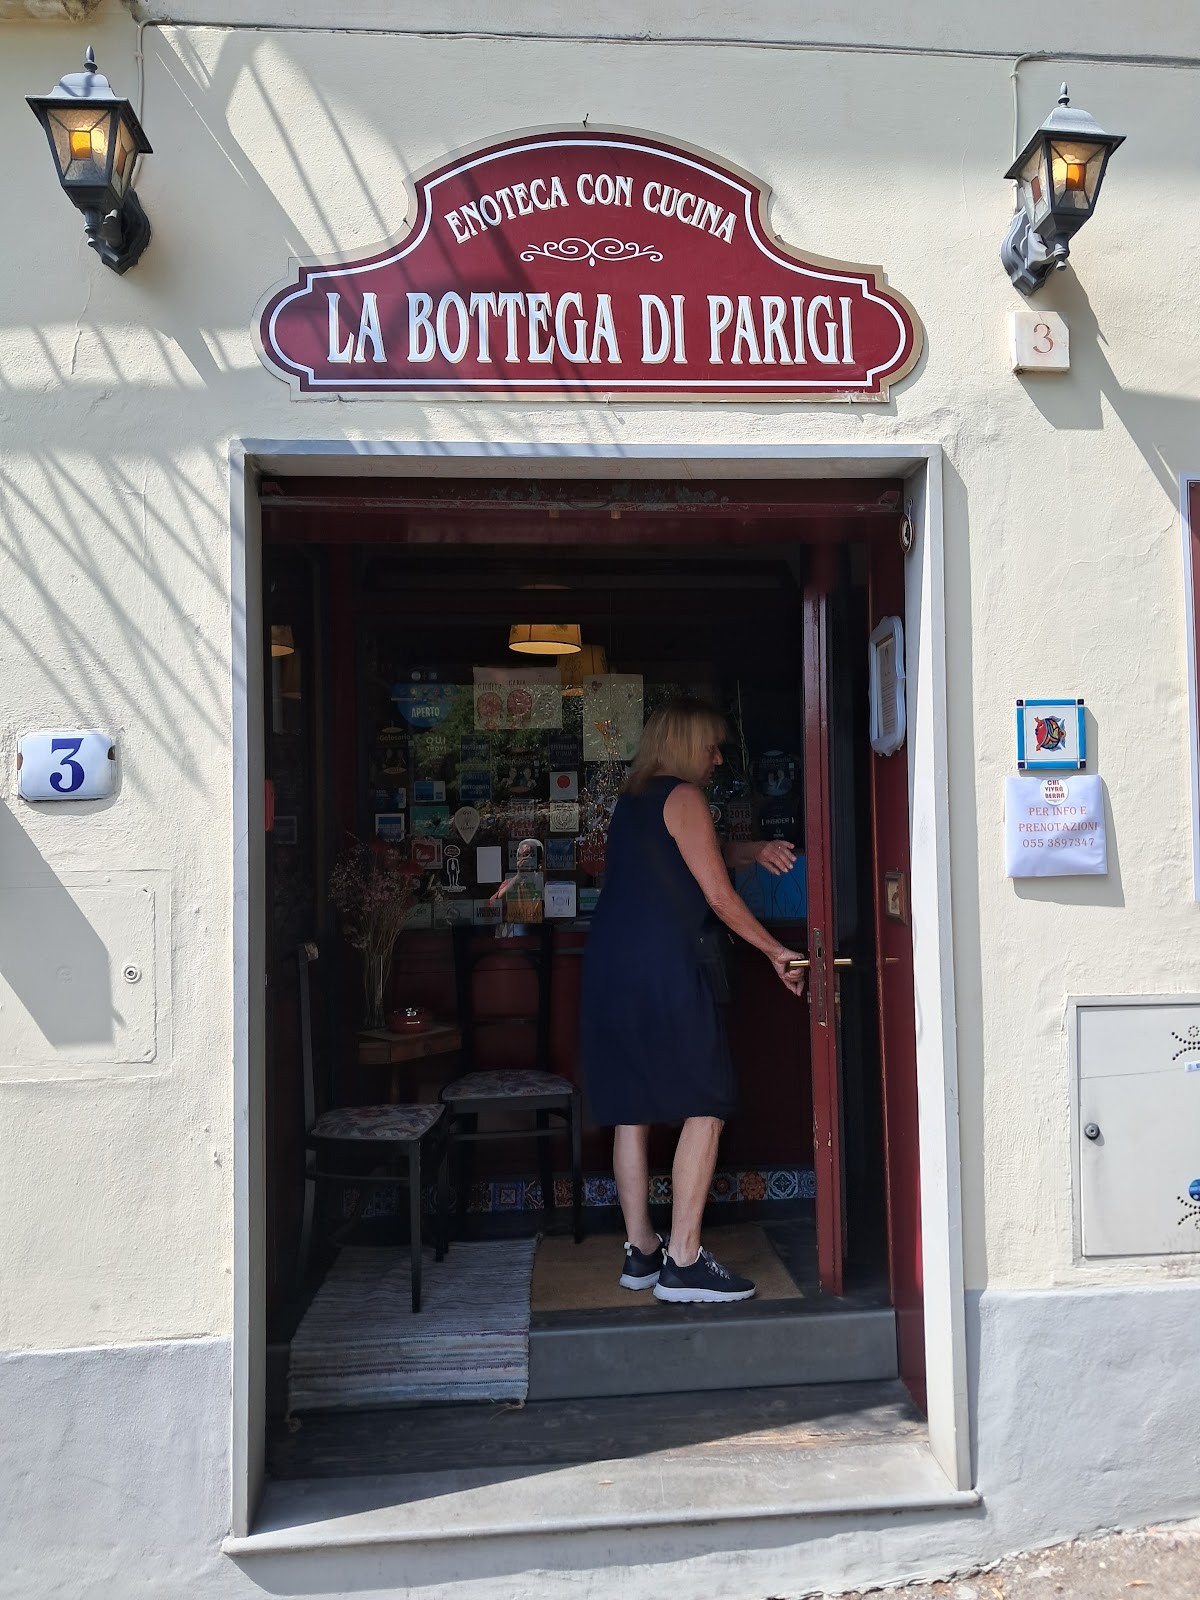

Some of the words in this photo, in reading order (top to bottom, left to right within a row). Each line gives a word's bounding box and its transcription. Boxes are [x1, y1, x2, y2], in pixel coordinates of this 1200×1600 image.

[444, 176, 568, 244] ENOTECA
[575, 173, 634, 207] CON
[642, 181, 738, 243] CUCINA
[326, 291, 388, 365] LA
[405, 291, 621, 365] BOTTEGA
[640, 293, 688, 366] DI
[707, 294, 855, 366] PARIGI
[1032, 323, 1054, 354] 3
[411, 706, 440, 718] APERTO
[425, 737, 446, 746] QUI
[49, 737, 85, 793] 3
[729, 810, 751, 819] 2018
[1028, 806, 1049, 816] PER
[1052, 806, 1077, 816] INFO
[1080, 806, 1087, 815] E
[1018, 821, 1097, 832] PRENOTAZIONI
[1022, 838, 1044, 848] 055
[1047, 838, 1095, 848] 3897347
